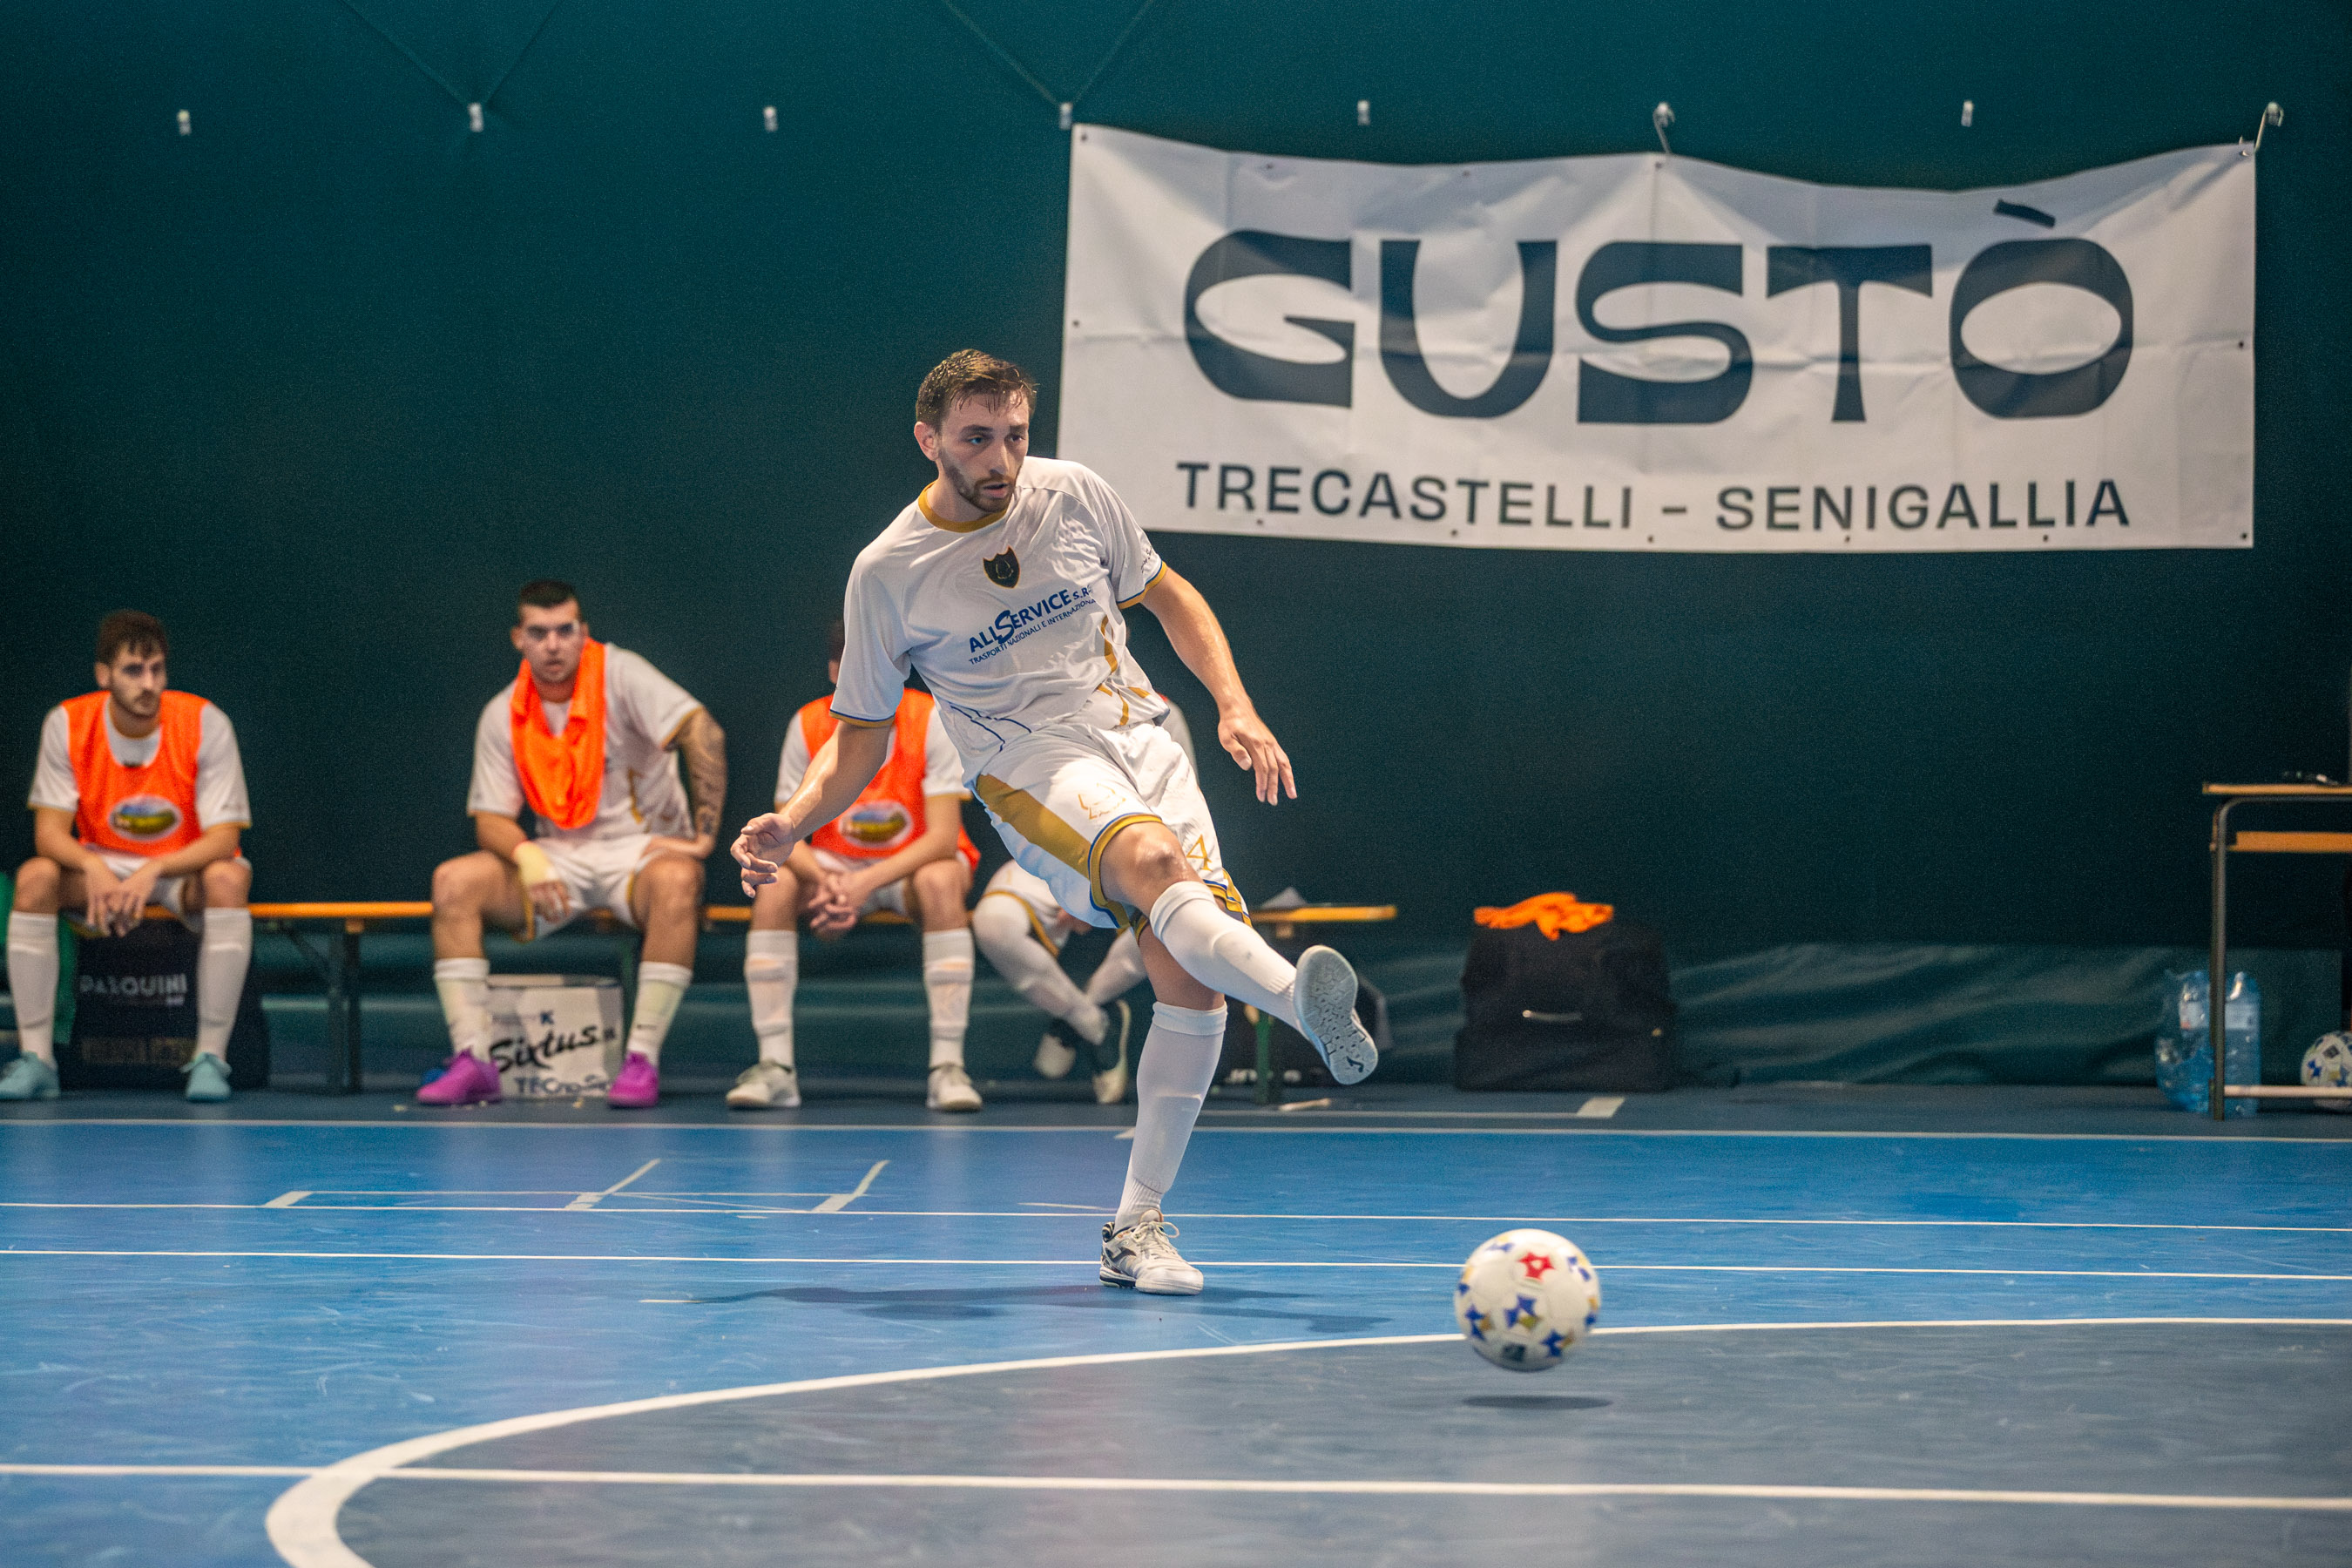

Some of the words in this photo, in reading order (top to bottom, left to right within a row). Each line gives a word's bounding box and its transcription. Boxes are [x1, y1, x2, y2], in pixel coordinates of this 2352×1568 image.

[1183, 198, 2134, 425] GUSTÒ
[1176, 462, 1632, 529] TRECASTELLI
[1716, 478, 2131, 531] SENIGALLIA
[969, 643, 1008, 665] TRASPORTI
[1007, 624, 1042, 646] NAZIONALI
